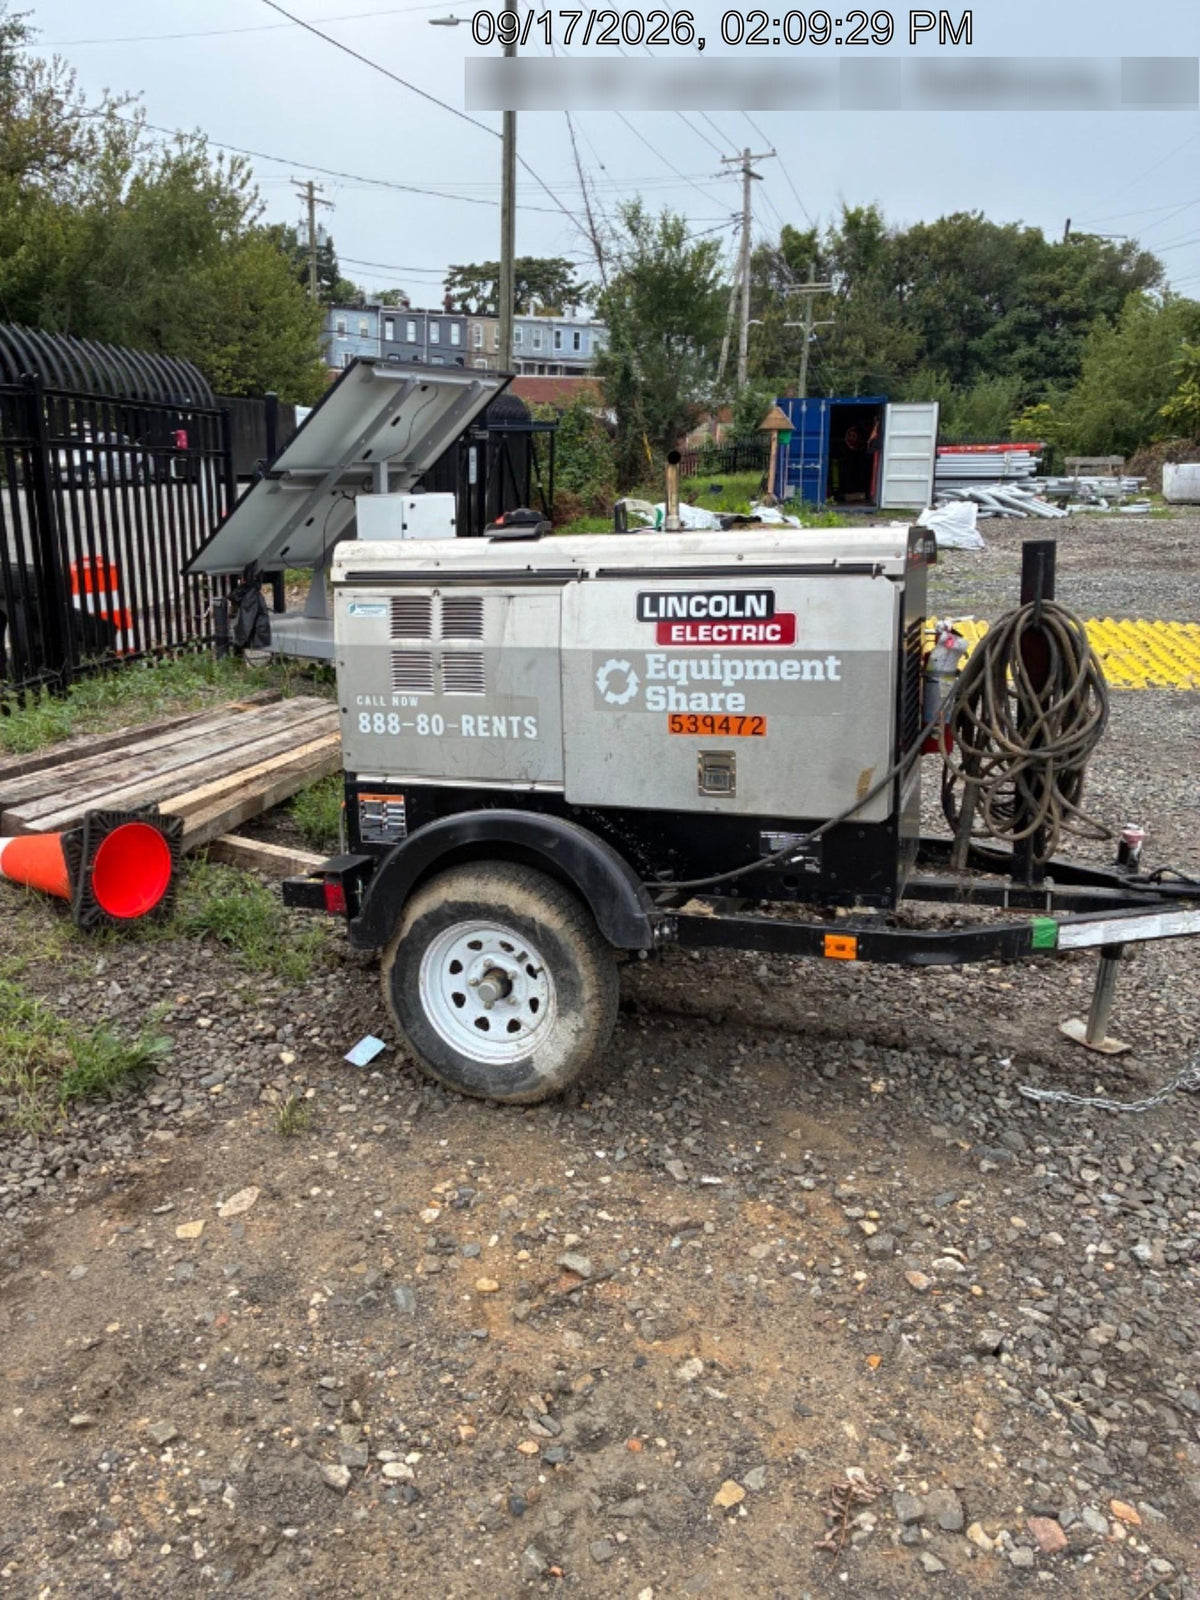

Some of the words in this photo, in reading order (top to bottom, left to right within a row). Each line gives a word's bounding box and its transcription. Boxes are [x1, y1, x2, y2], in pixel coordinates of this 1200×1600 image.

[643, 594, 768, 618] LINCOLN
[671, 624, 781, 642] ELECTRIC
[645, 653, 841, 686] Equipment
[356, 695, 386, 706] CALL
[392, 696, 419, 706] NOW
[646, 685, 746, 712] Share
[359, 712, 538, 738] 888-80-RENTS
[671, 715, 765, 735] 539472
